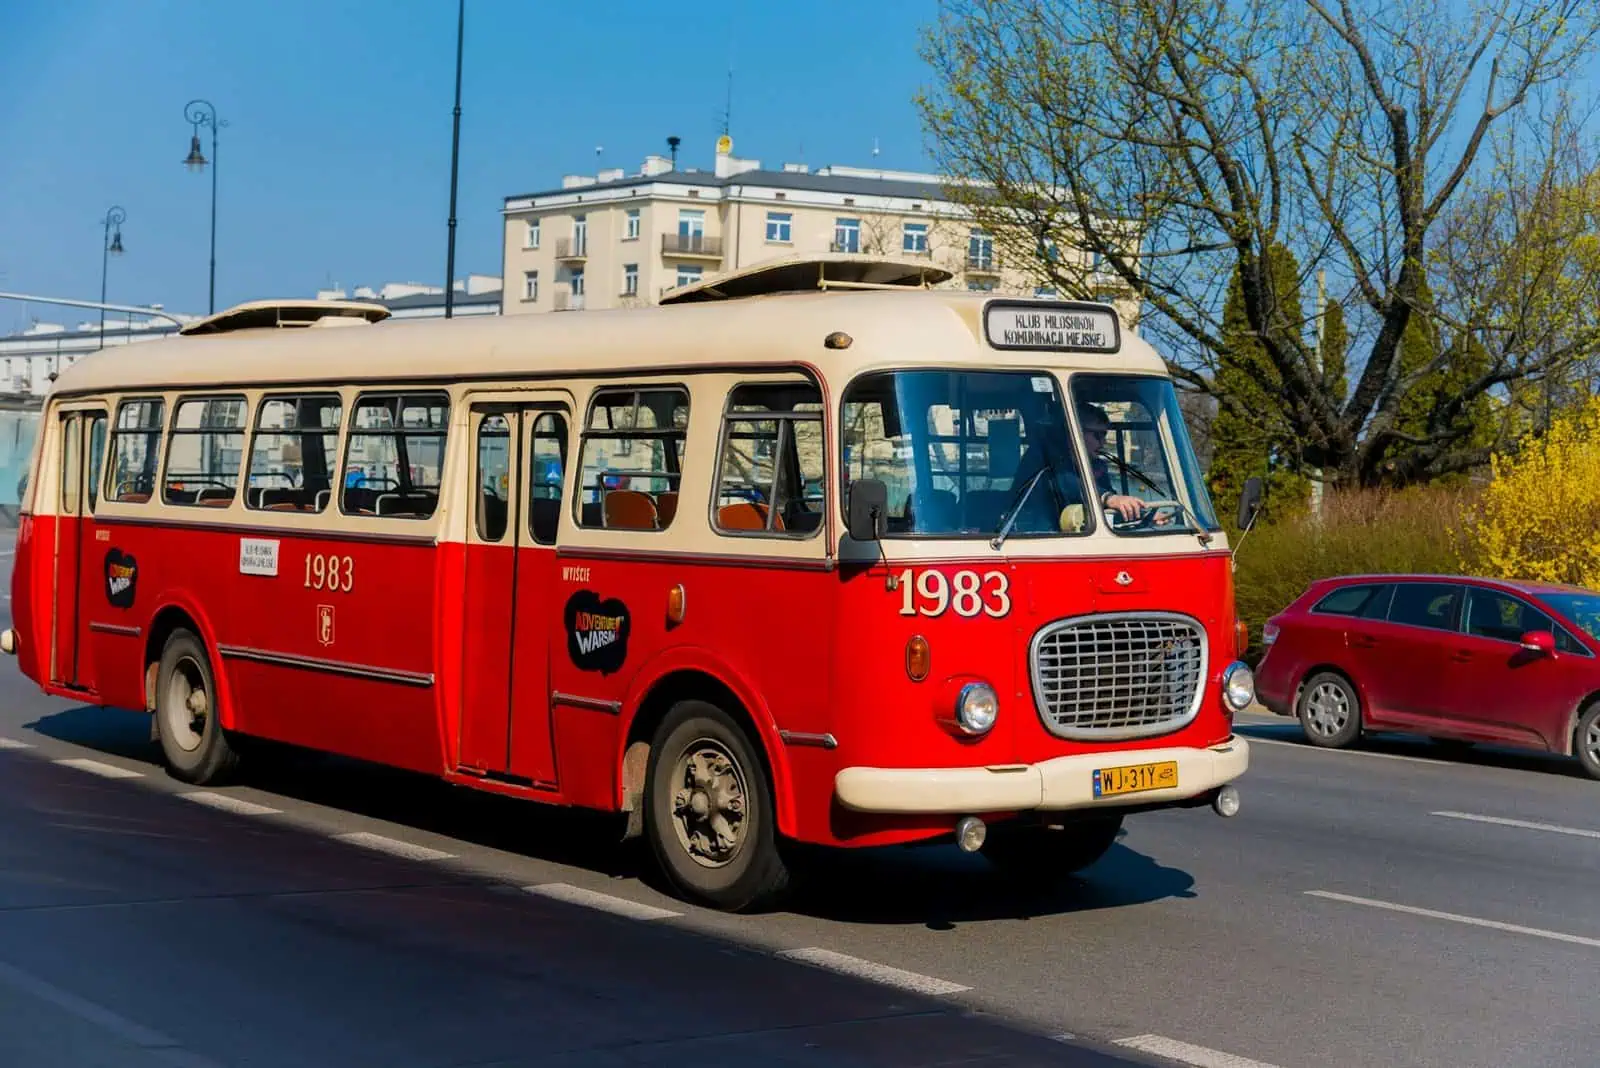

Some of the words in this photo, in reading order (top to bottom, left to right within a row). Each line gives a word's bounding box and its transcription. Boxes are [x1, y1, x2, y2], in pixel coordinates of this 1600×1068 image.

[1015, 314, 1041, 329] KLUB
[1004, 329, 1064, 345] KOMUNIKACJI
[304, 552, 353, 592] 1983
[899, 568, 1011, 617] 1983
